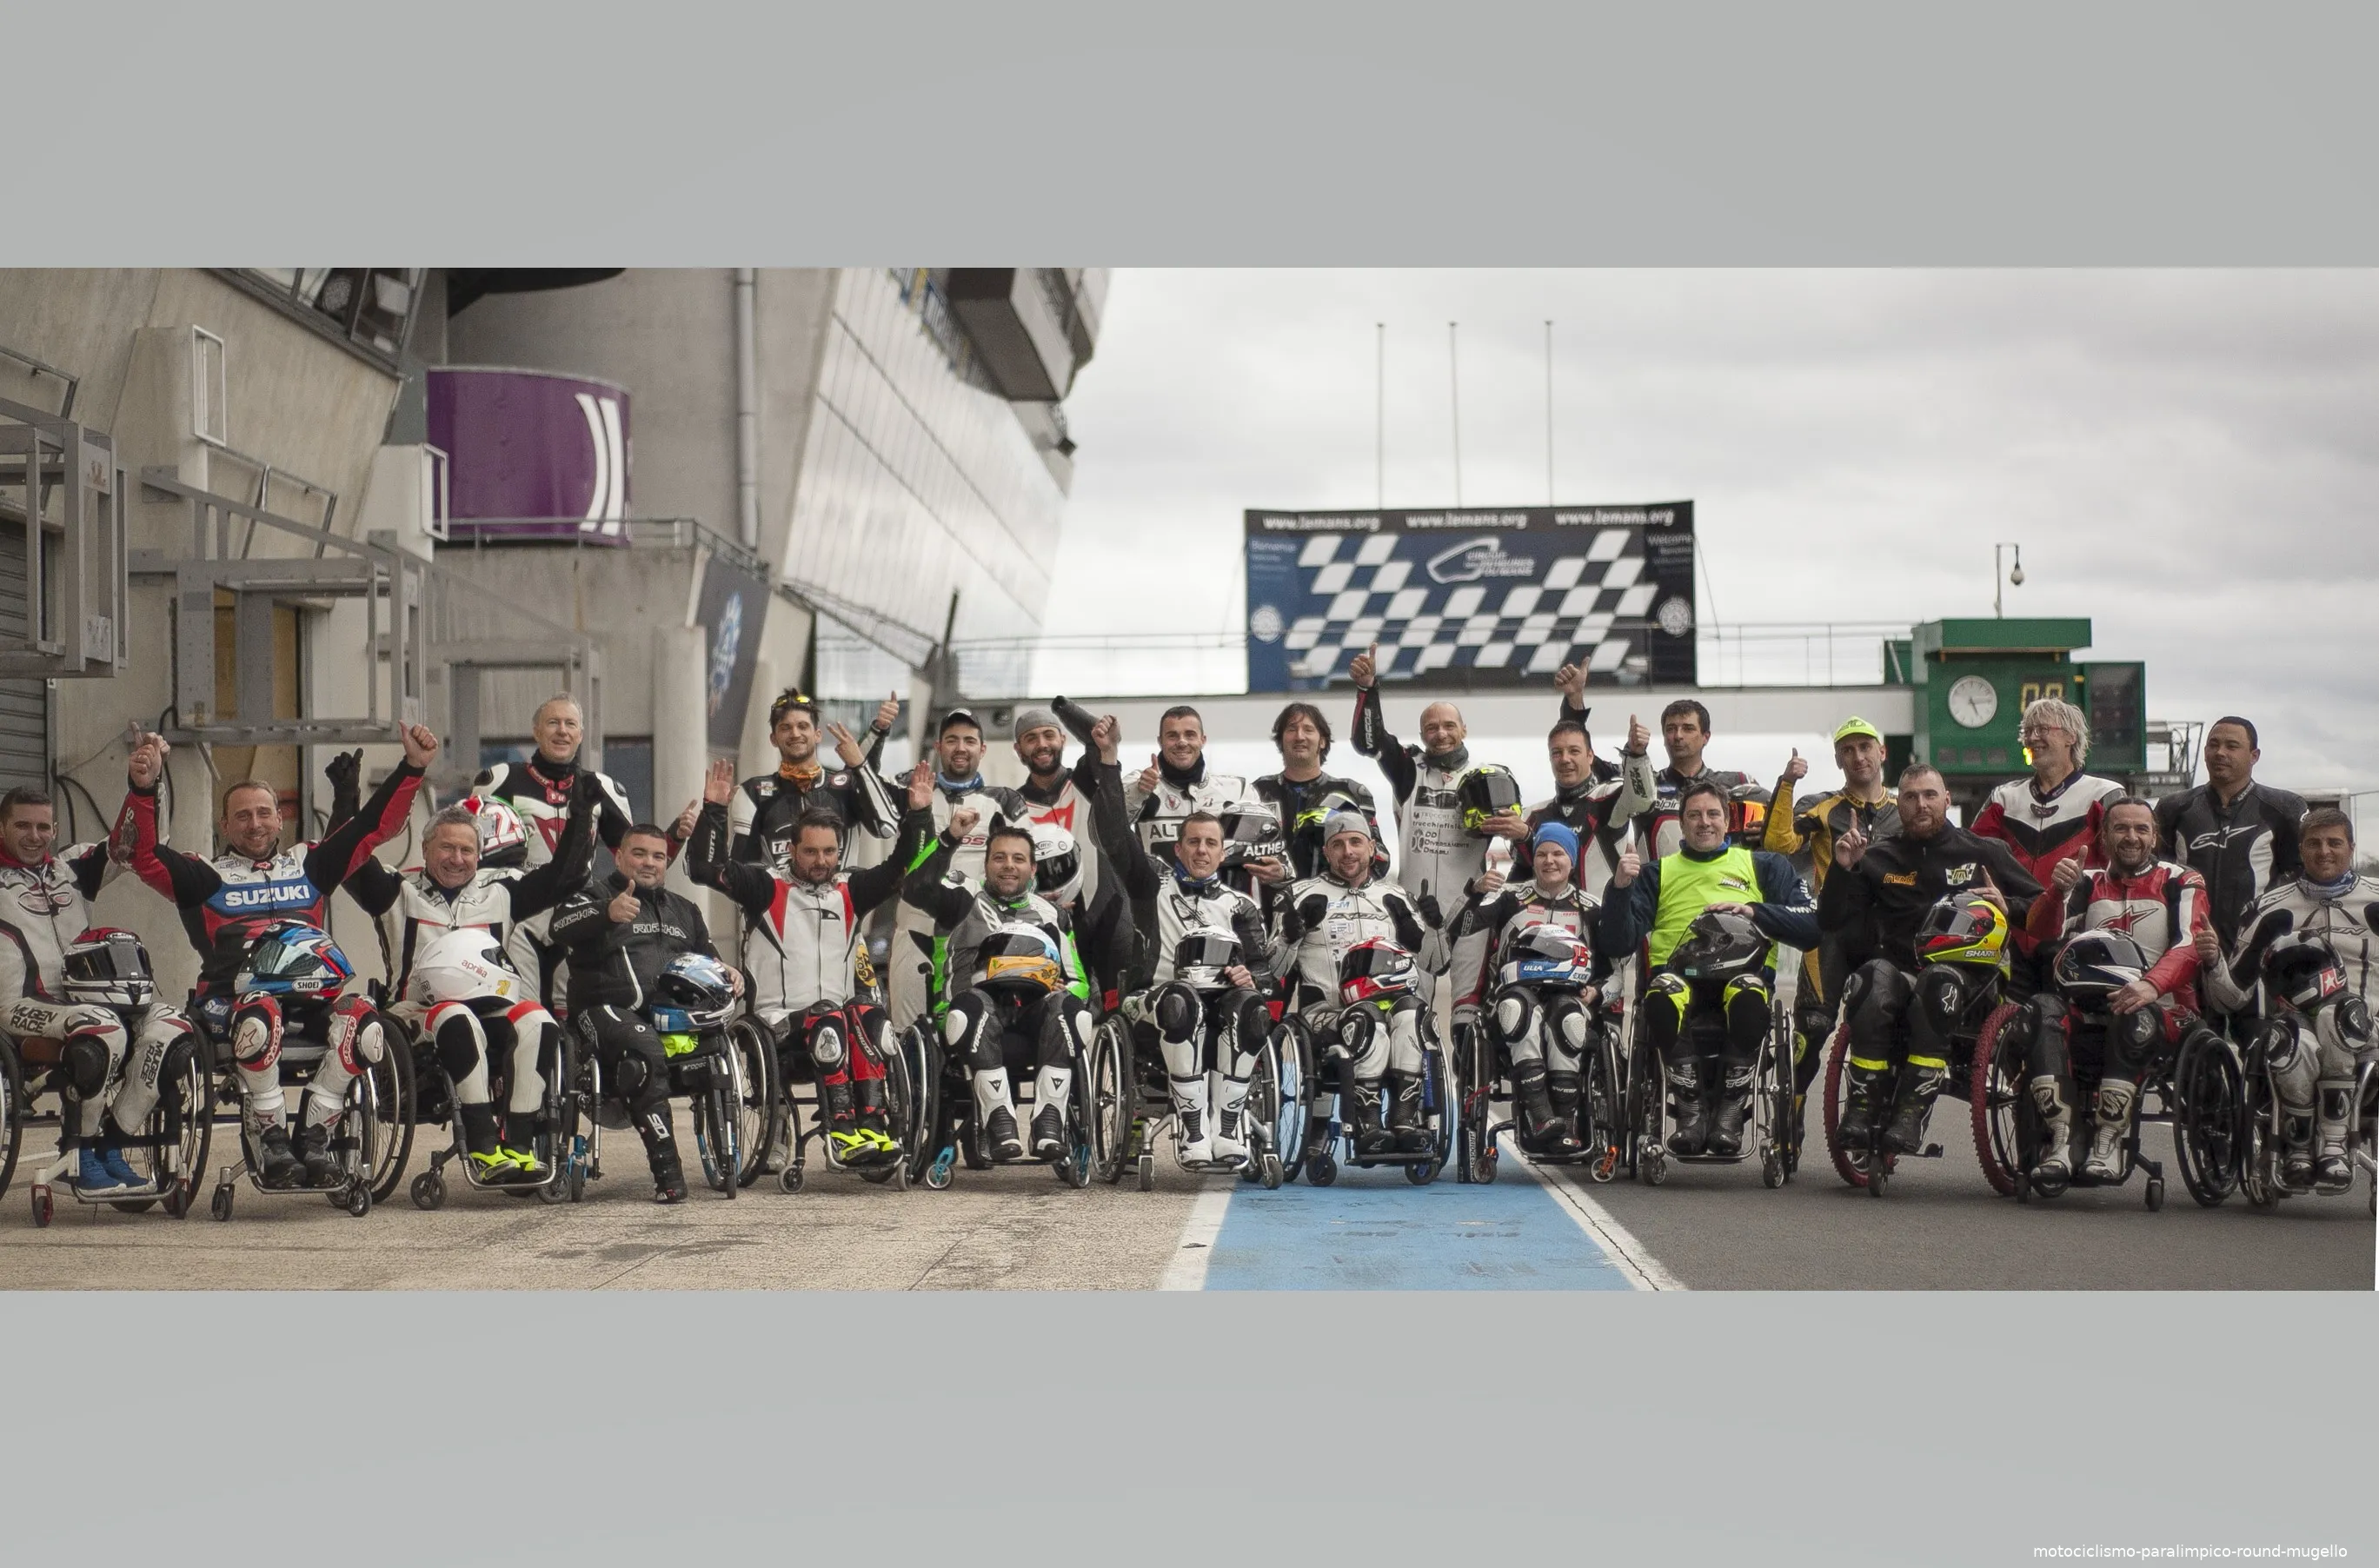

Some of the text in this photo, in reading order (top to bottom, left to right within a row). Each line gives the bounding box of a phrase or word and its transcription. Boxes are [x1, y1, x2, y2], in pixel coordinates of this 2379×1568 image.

[1262, 515, 1381, 532] www.lemans.org
[1405, 513, 1528, 529] www.lemans.org
[1555, 508, 1674, 526] www.lemans.org
[225, 885, 310, 907] SUZUKI
[461, 960, 488, 978] aprilia
[10, 1004, 57, 1022] MUGEN
[10, 1016, 45, 1034] RACE
[972, 1011, 989, 1053] VIRCOS
[1058, 1013, 1076, 1056] VIRCOS
[140, 1045, 153, 1080] RACE
[145, 1040, 164, 1089] MUGEN
